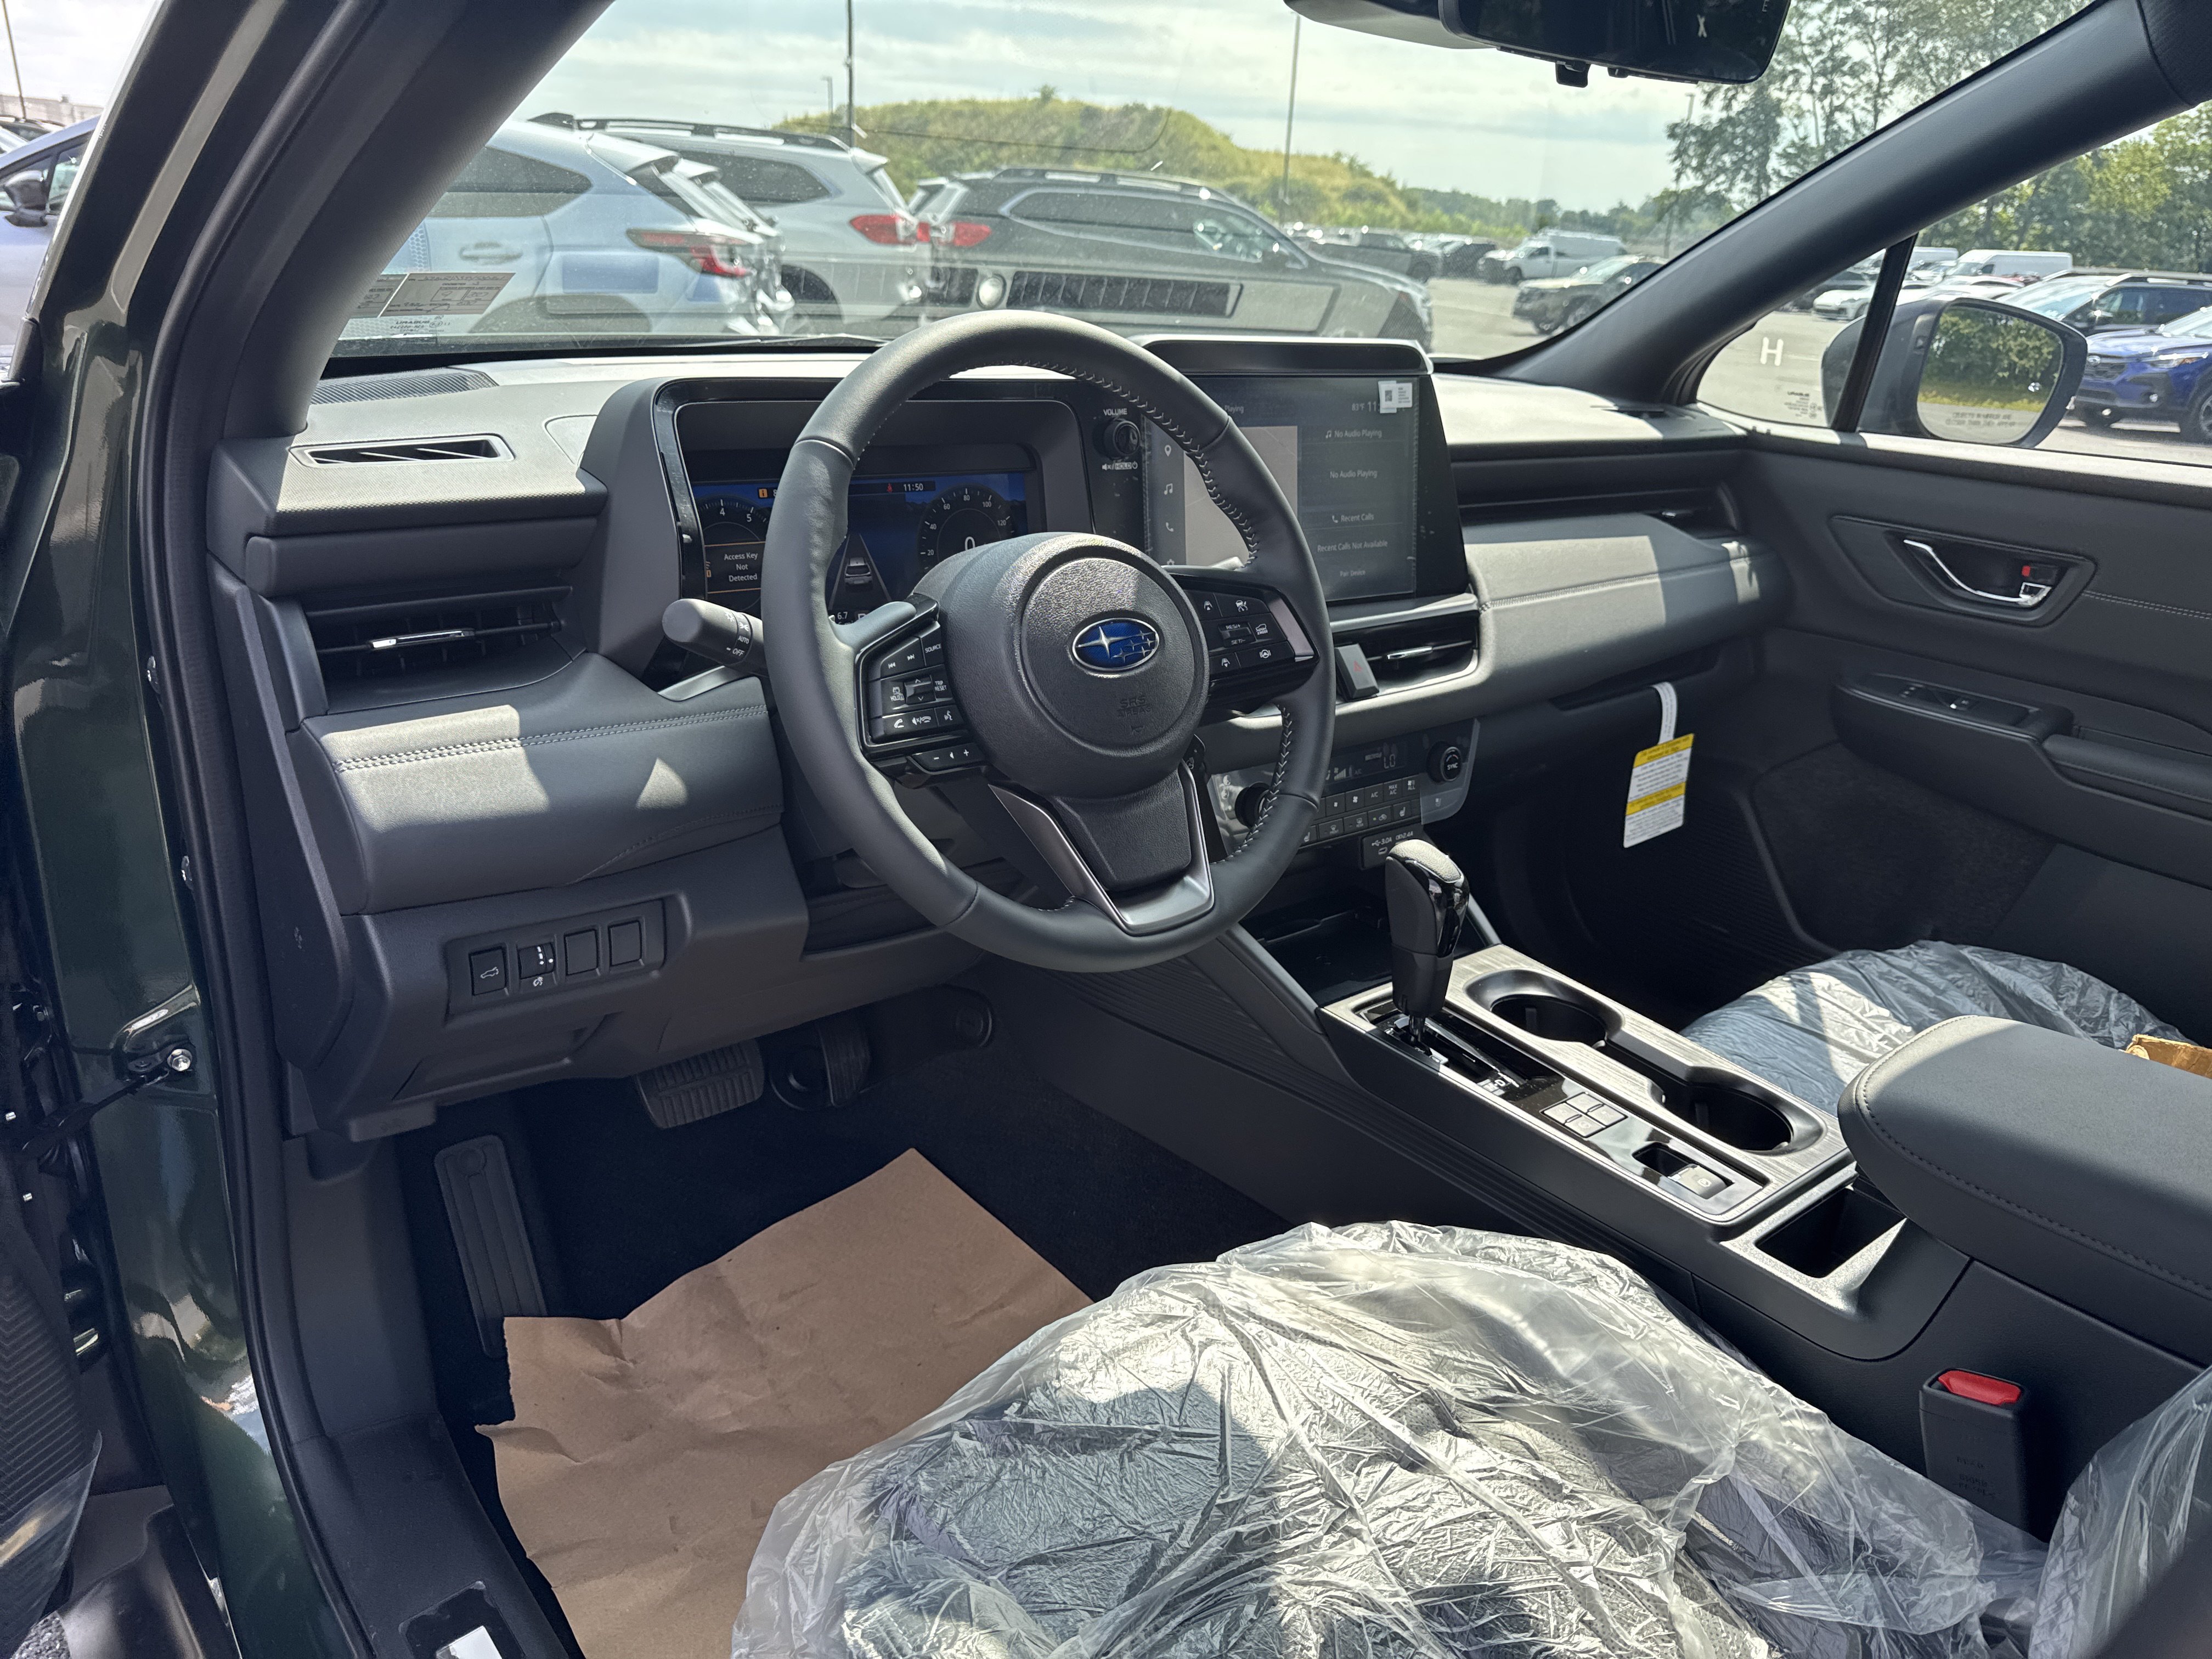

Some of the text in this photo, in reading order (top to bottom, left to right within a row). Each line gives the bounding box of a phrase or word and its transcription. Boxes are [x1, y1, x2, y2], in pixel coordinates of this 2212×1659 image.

[1760, 337, 1784, 366] H
[1103, 408, 1127, 416] VOLUME
[1344, 430, 1361, 438] Audio
[1361, 429, 1383, 439] Playing
[1329, 469, 1378, 479] No Audio Playing
[903, 483, 924, 492] 11:50
[719, 507, 725, 516] 4
[746, 514, 752, 522] 5
[1317, 544, 1337, 552] Recent
[1338, 542, 1351, 550] Calls
[1364, 539, 1388, 548] Available
[746, 552, 758, 560] Key
[729, 573, 758, 583] Detected
[837, 611, 848, 620] 6.7
[737, 635, 749, 644] AUTO
[732, 648, 745, 656] OFF
[924, 644, 942, 653] SOURCE
[1447, 762, 1458, 770] SYNC
[1380, 837, 1392, 845] 3.0A
